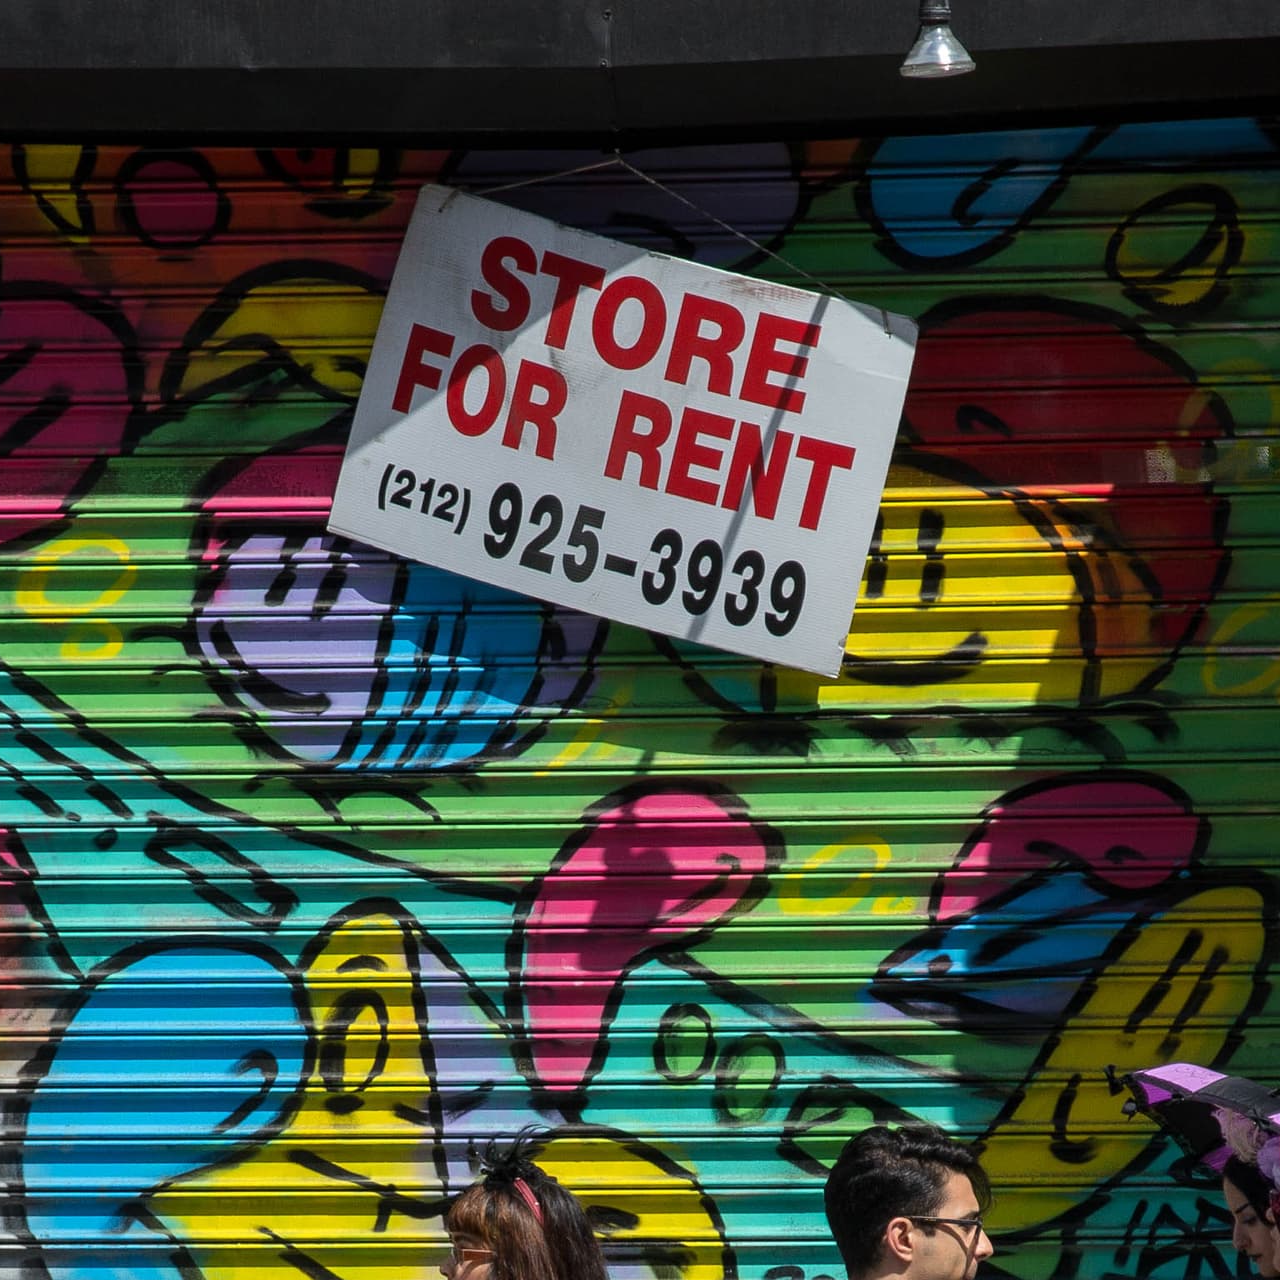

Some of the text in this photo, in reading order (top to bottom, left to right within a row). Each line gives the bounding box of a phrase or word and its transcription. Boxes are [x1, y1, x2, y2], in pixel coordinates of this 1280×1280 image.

[471, 236, 823, 415] STORE
[391, 323, 857, 532] FOR RENT
[377, 463, 807, 638] (212) 925-3939
